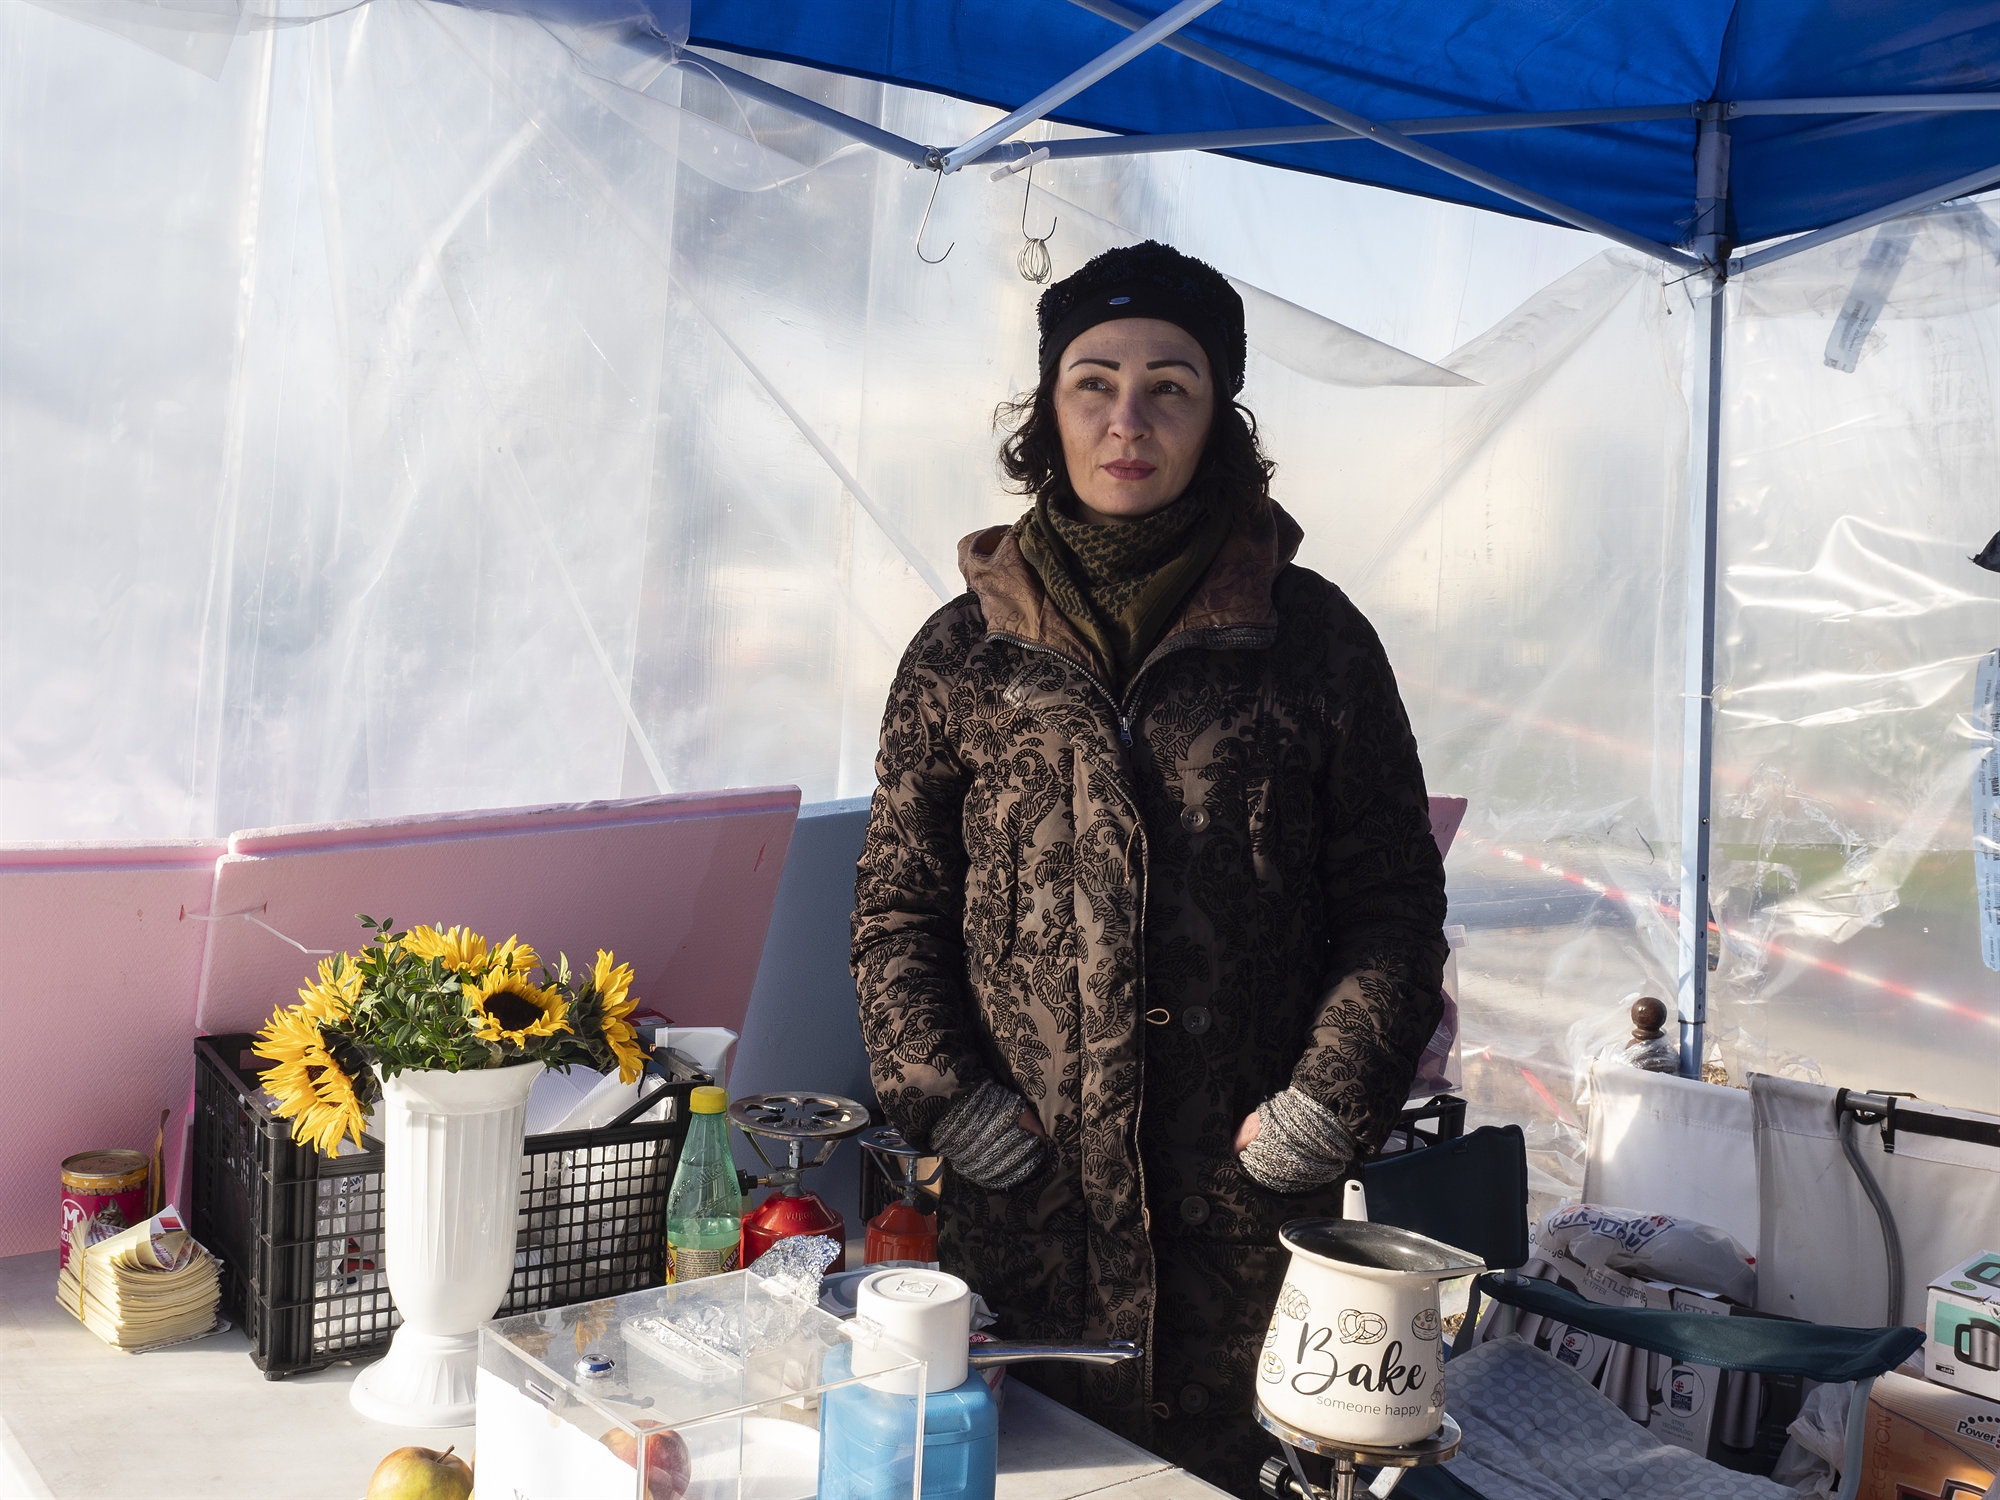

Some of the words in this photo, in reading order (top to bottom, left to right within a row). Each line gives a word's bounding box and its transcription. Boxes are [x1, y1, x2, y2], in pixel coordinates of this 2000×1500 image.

[1585, 1265, 1630, 1299] KETTLE
[1675, 1301, 1720, 1316] KETT
[1290, 1322, 1427, 1396] Bake
[1316, 1395, 1382, 1416] someone
[1385, 1404, 1422, 1418] happy
[1956, 1420, 1997, 1442] Power
